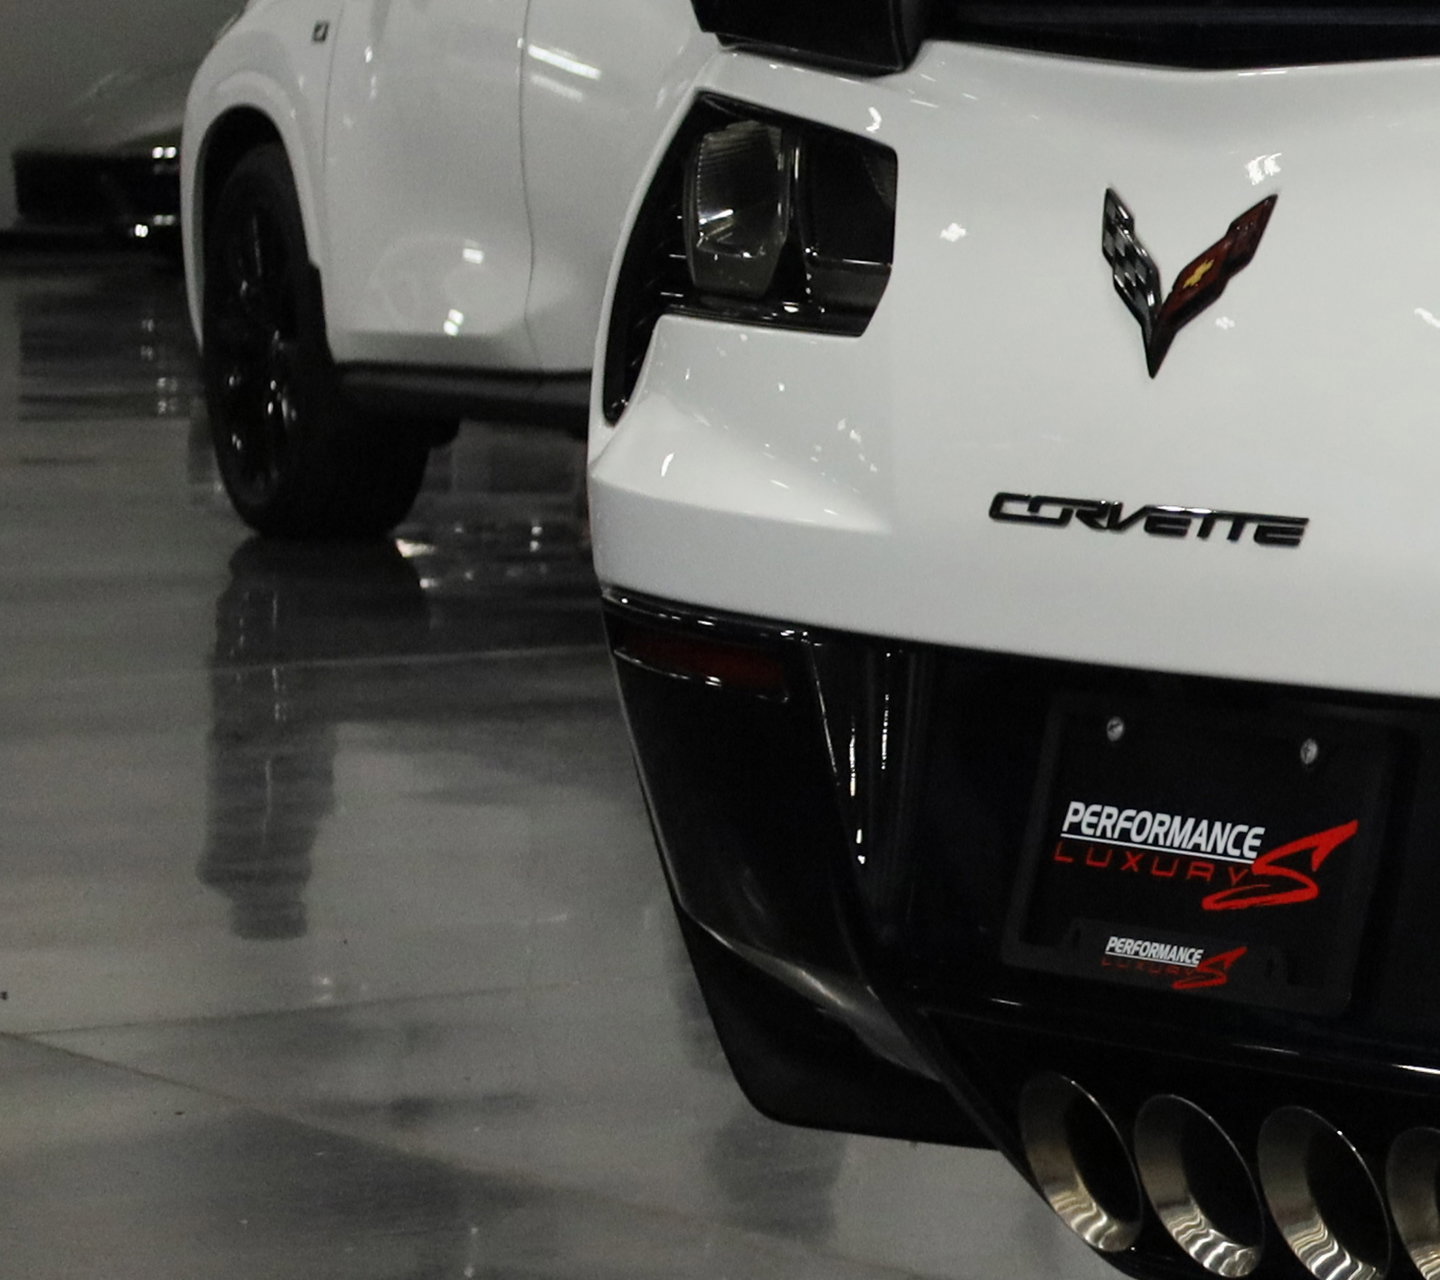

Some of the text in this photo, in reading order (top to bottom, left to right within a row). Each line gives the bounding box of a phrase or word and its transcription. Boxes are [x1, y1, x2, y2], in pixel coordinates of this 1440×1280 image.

[989, 492, 1309, 546] CORVETTE
[1061, 800, 1265, 859] PERFORMANCE
[1053, 840, 1252, 887] LUXURY
[1105, 935, 1204, 964] PERFORMANCE
